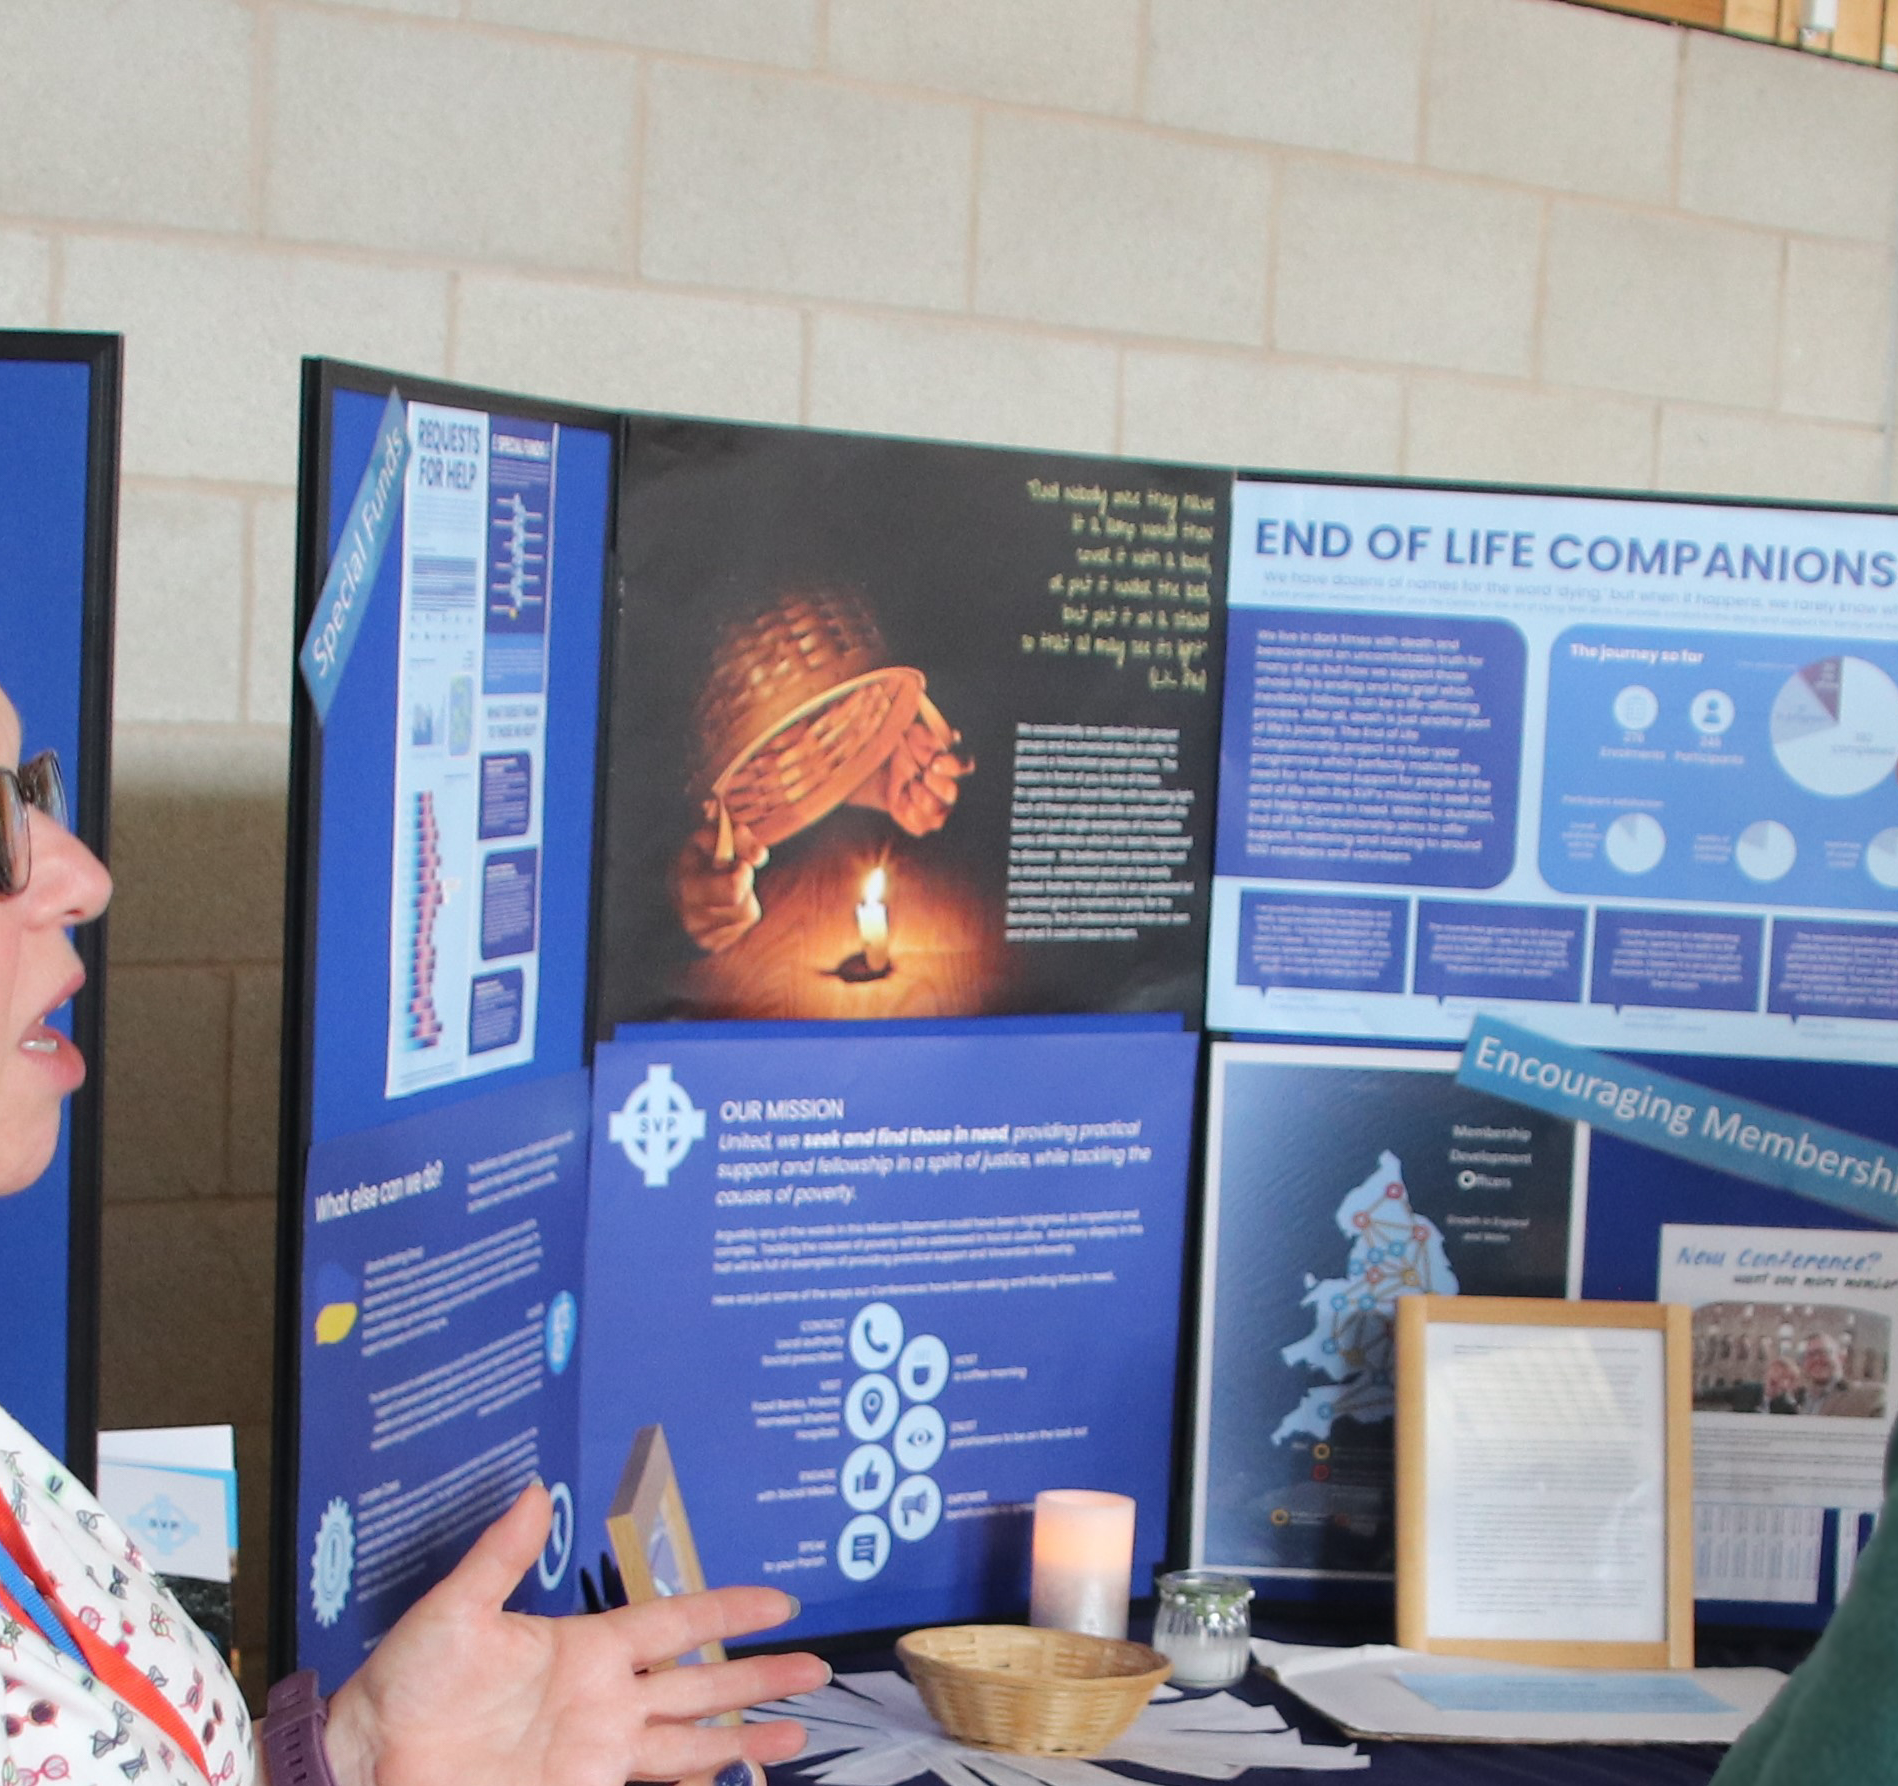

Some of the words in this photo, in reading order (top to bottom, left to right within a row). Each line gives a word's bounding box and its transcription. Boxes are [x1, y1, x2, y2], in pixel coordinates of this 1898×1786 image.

[418, 418, 481, 456] REQUESTS
[418, 456, 441, 488] FOR
[447, 459, 477, 490] HELP
[312, 536, 366, 678] Special
[361, 427, 403, 543] Funds
[1255, 518, 1352, 561] END
[1368, 524, 1431, 564] OF
[1445, 528, 1536, 569] LIFE
[1570, 643, 1598, 657] The
[1600, 646, 1658, 665] journey
[1661, 650, 1679, 662] so
[1681, 647, 1703, 663] far
[1474, 1036, 1697, 1137] Encouraging
[720, 1100, 762, 1122] OUR
[765, 1098, 844, 1121] MISSION
[639, 1119, 677, 1133] SVP
[776, 1134, 800, 1149] we
[804, 1131, 841, 1149] seek
[844, 1129, 874, 1148] and
[877, 1127, 908, 1146] find
[910, 1125, 952, 1145] those
[955, 1125, 968, 1143] in
[1012, 1122, 1076, 1144] providing
[1079, 1120, 1141, 1142] practical
[1452, 1124, 1532, 1142] Membership
[717, 1160, 778, 1180] support
[781, 1157, 813, 1175] and
[816, 1154, 893, 1178] fellowship
[897, 1154, 908, 1172] in
[911, 1156, 924, 1170] a
[927, 1150, 962, 1174] spirit
[965, 1149, 979, 1170] of
[1035, 1147, 1069, 1167] while
[1071, 1145, 1125, 1168] tackling
[1128, 1144, 1151, 1163] the
[1449, 1148, 1532, 1167] Development
[315, 1188, 350, 1222] What
[351, 1181, 379, 1214] else
[380, 1177, 404, 1206] can
[405, 1171, 421, 1195] we
[422, 1159, 444, 1190] do?
[1457, 1169, 1512, 1191] Officers
[714, 1186, 773, 1206] causes
[775, 1184, 794, 1203] of
[794, 1184, 856, 1206] poverty.
[1678, 1247, 1725, 1266] New
[1737, 1249, 1882, 1271] Conference?
